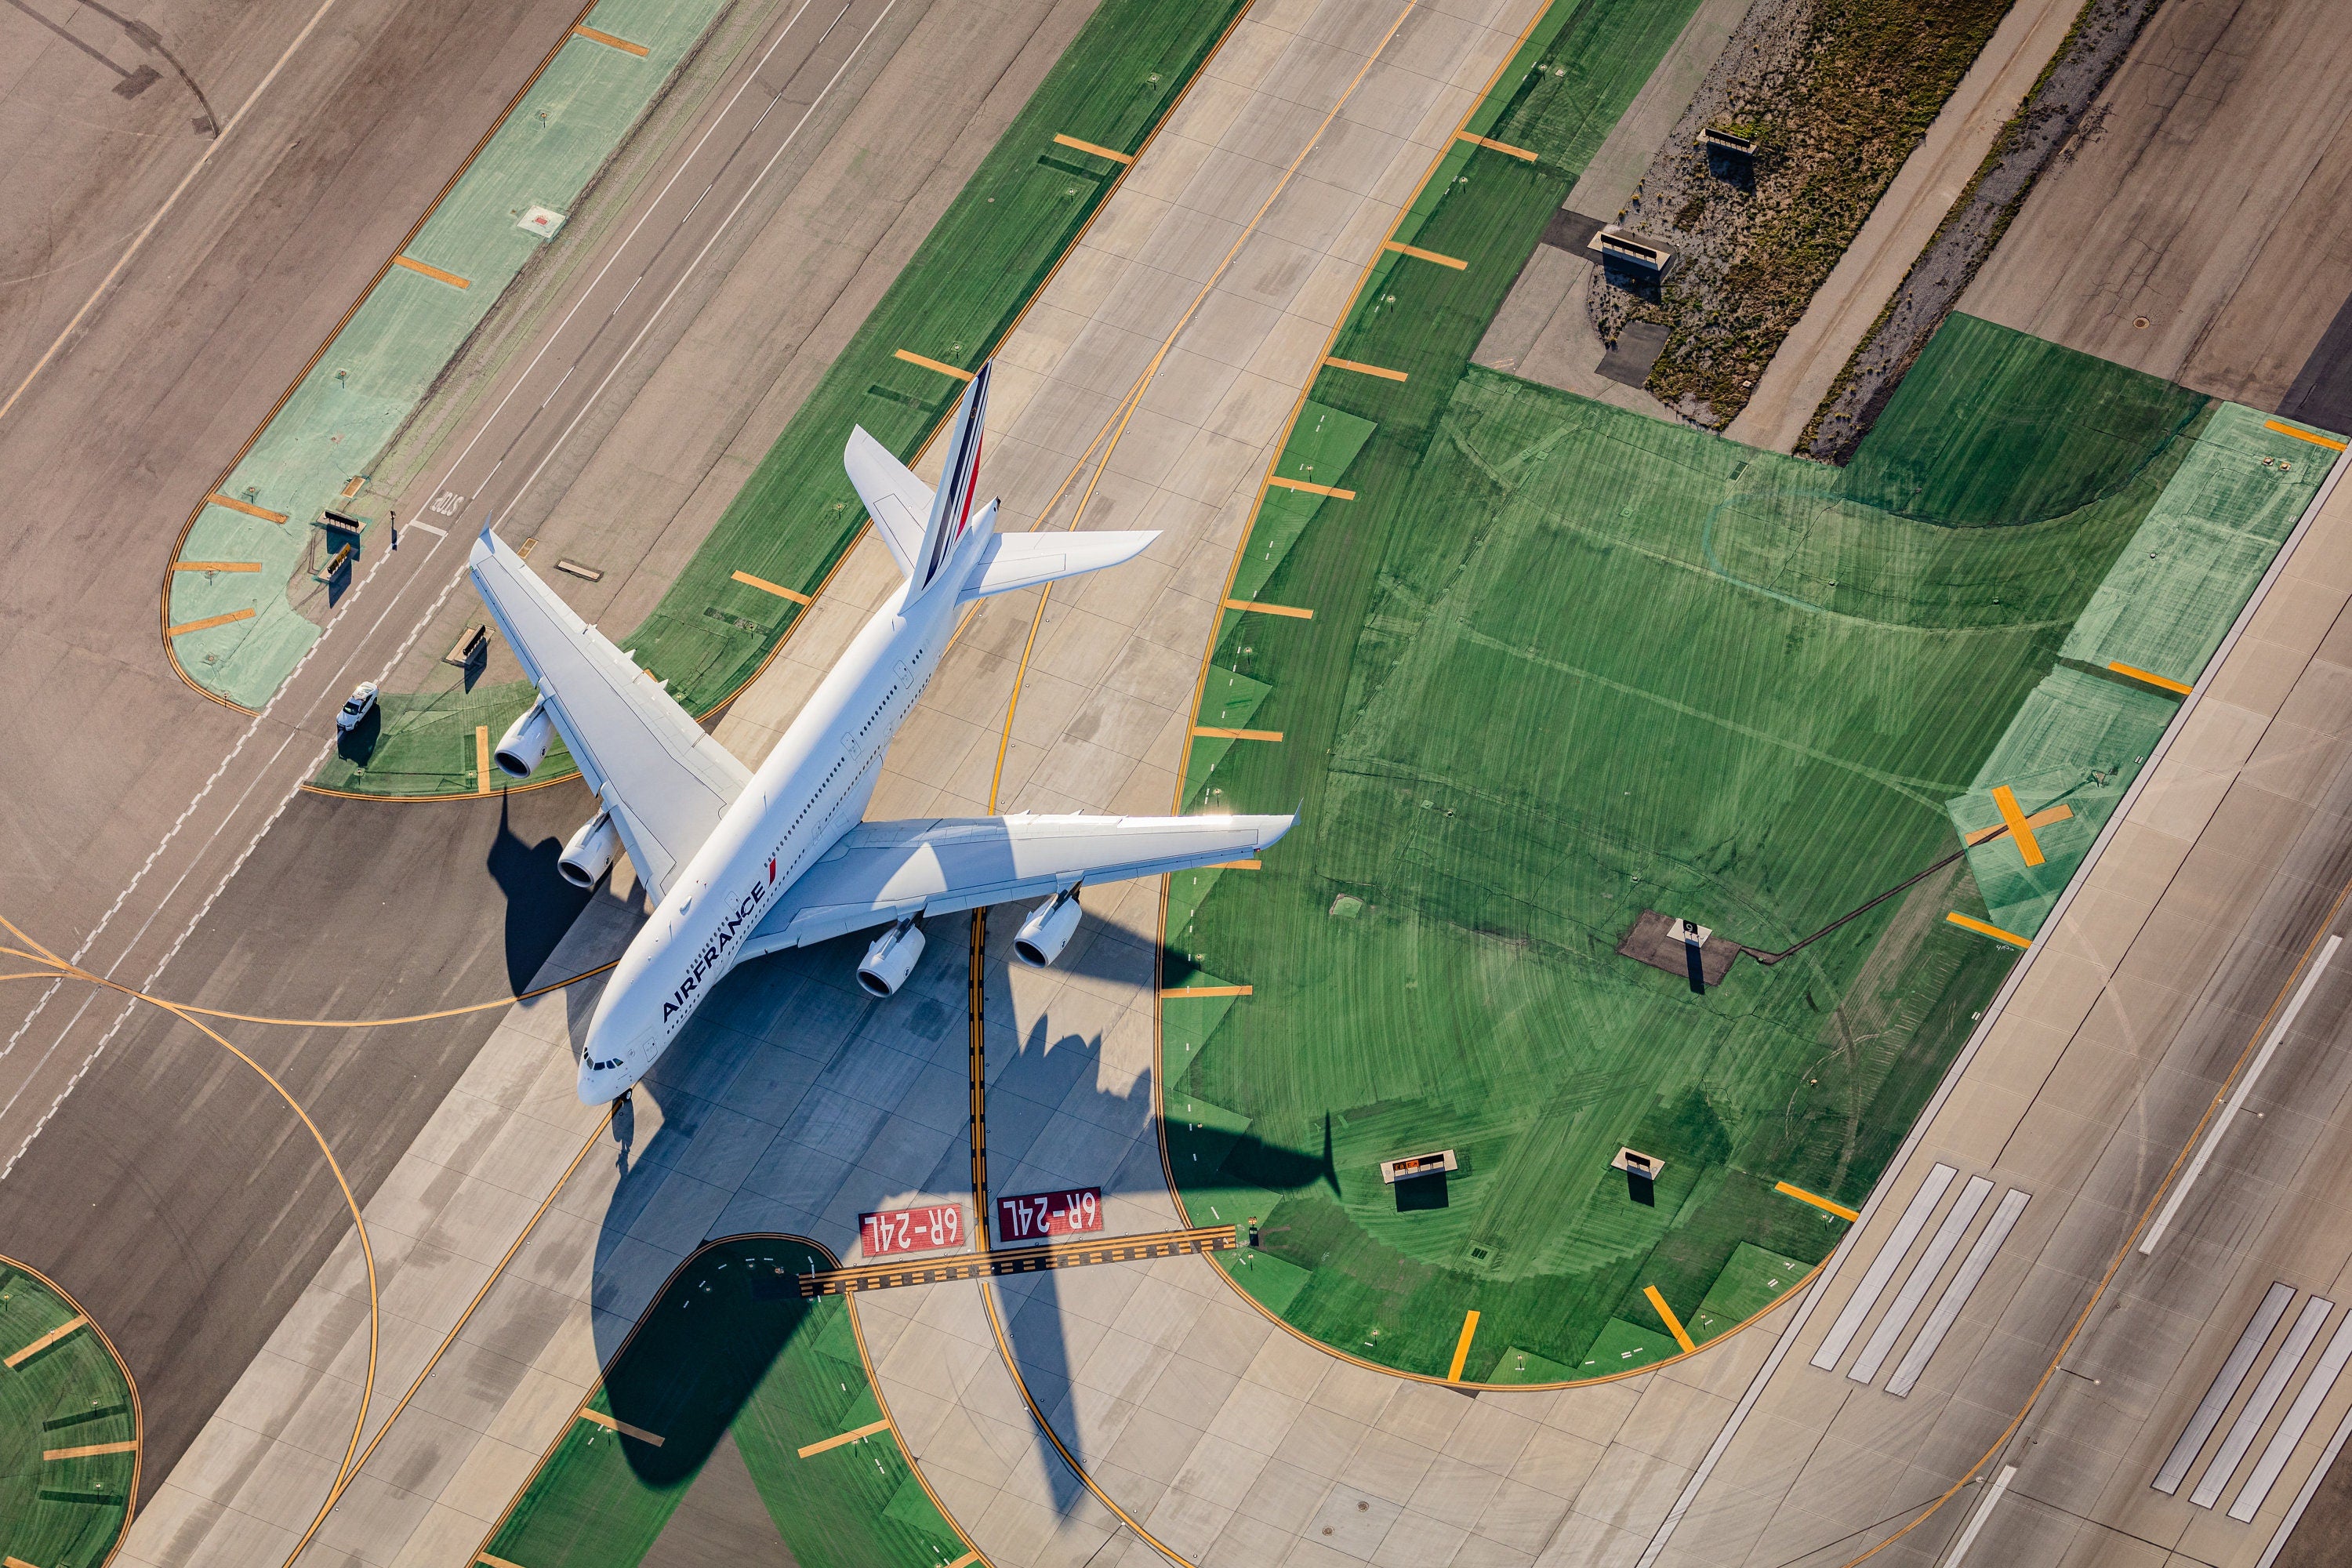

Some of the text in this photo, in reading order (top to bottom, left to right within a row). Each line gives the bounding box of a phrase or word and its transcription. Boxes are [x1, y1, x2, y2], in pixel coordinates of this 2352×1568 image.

[430, 491, 464, 517] STOP
[662, 880, 766, 1024] AIRFRANCE
[864, 1207, 958, 1253] 6R-24L
[1004, 1192, 1096, 1236] 6R-24L
